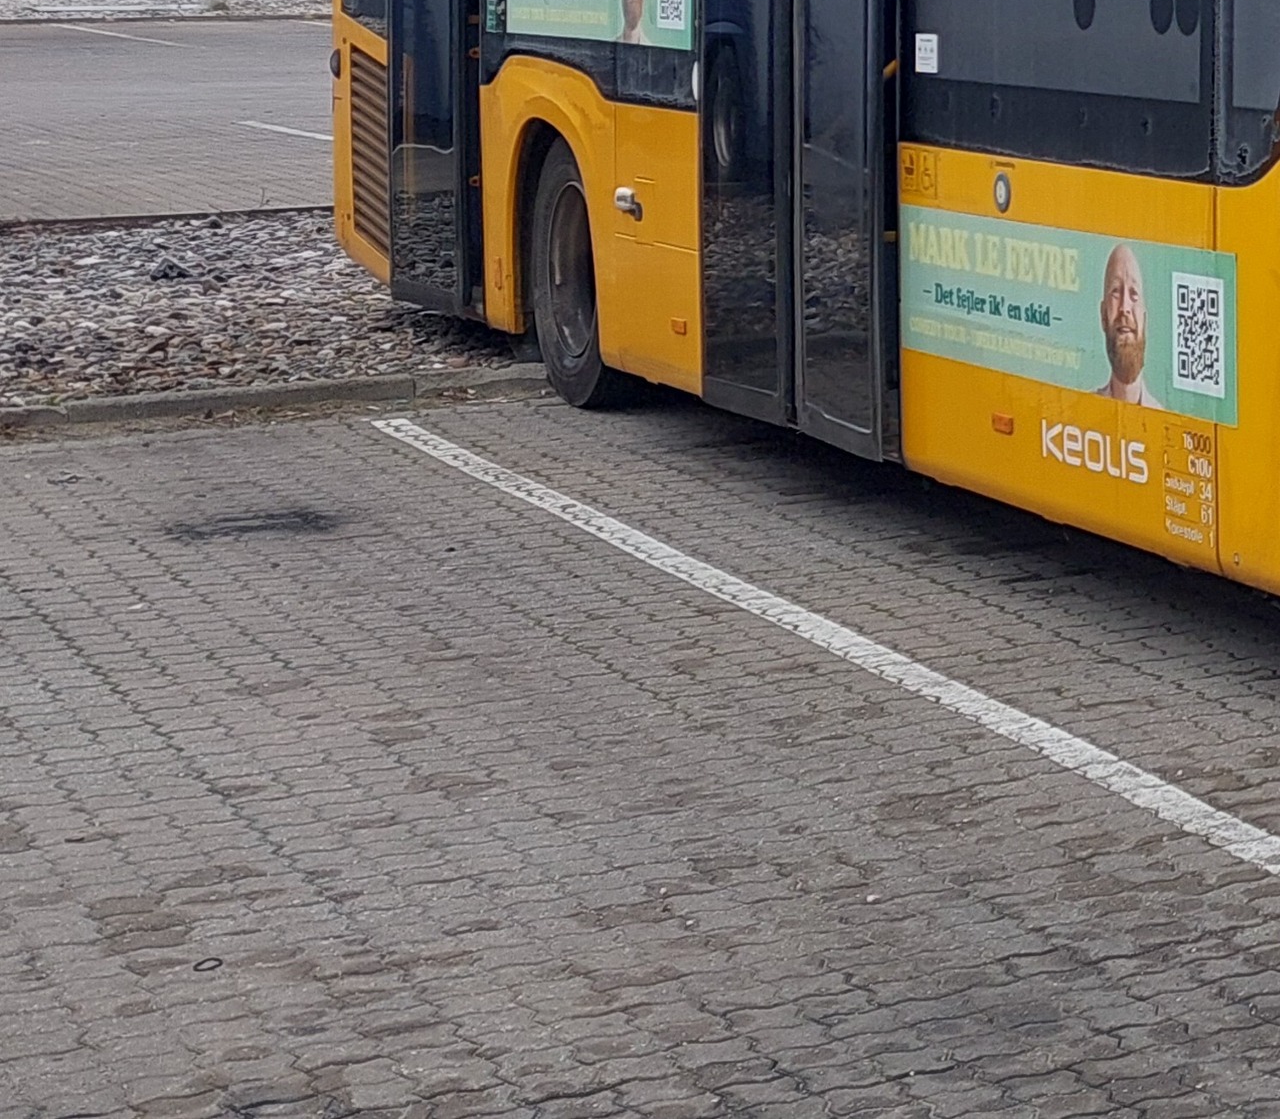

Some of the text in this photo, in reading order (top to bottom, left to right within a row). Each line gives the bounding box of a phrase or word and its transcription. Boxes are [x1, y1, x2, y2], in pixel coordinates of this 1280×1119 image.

[909, 222, 970, 271] MARK
[974, 233, 1000, 277] LE
[934, 283, 953, 305] Det
[956, 287, 986, 315] fejler
[1007, 301, 1022, 321] en
[1024, 302, 1050, 327] skid
[1199, 481, 1213, 501] 34
[1200, 504, 1213, 525] 61
